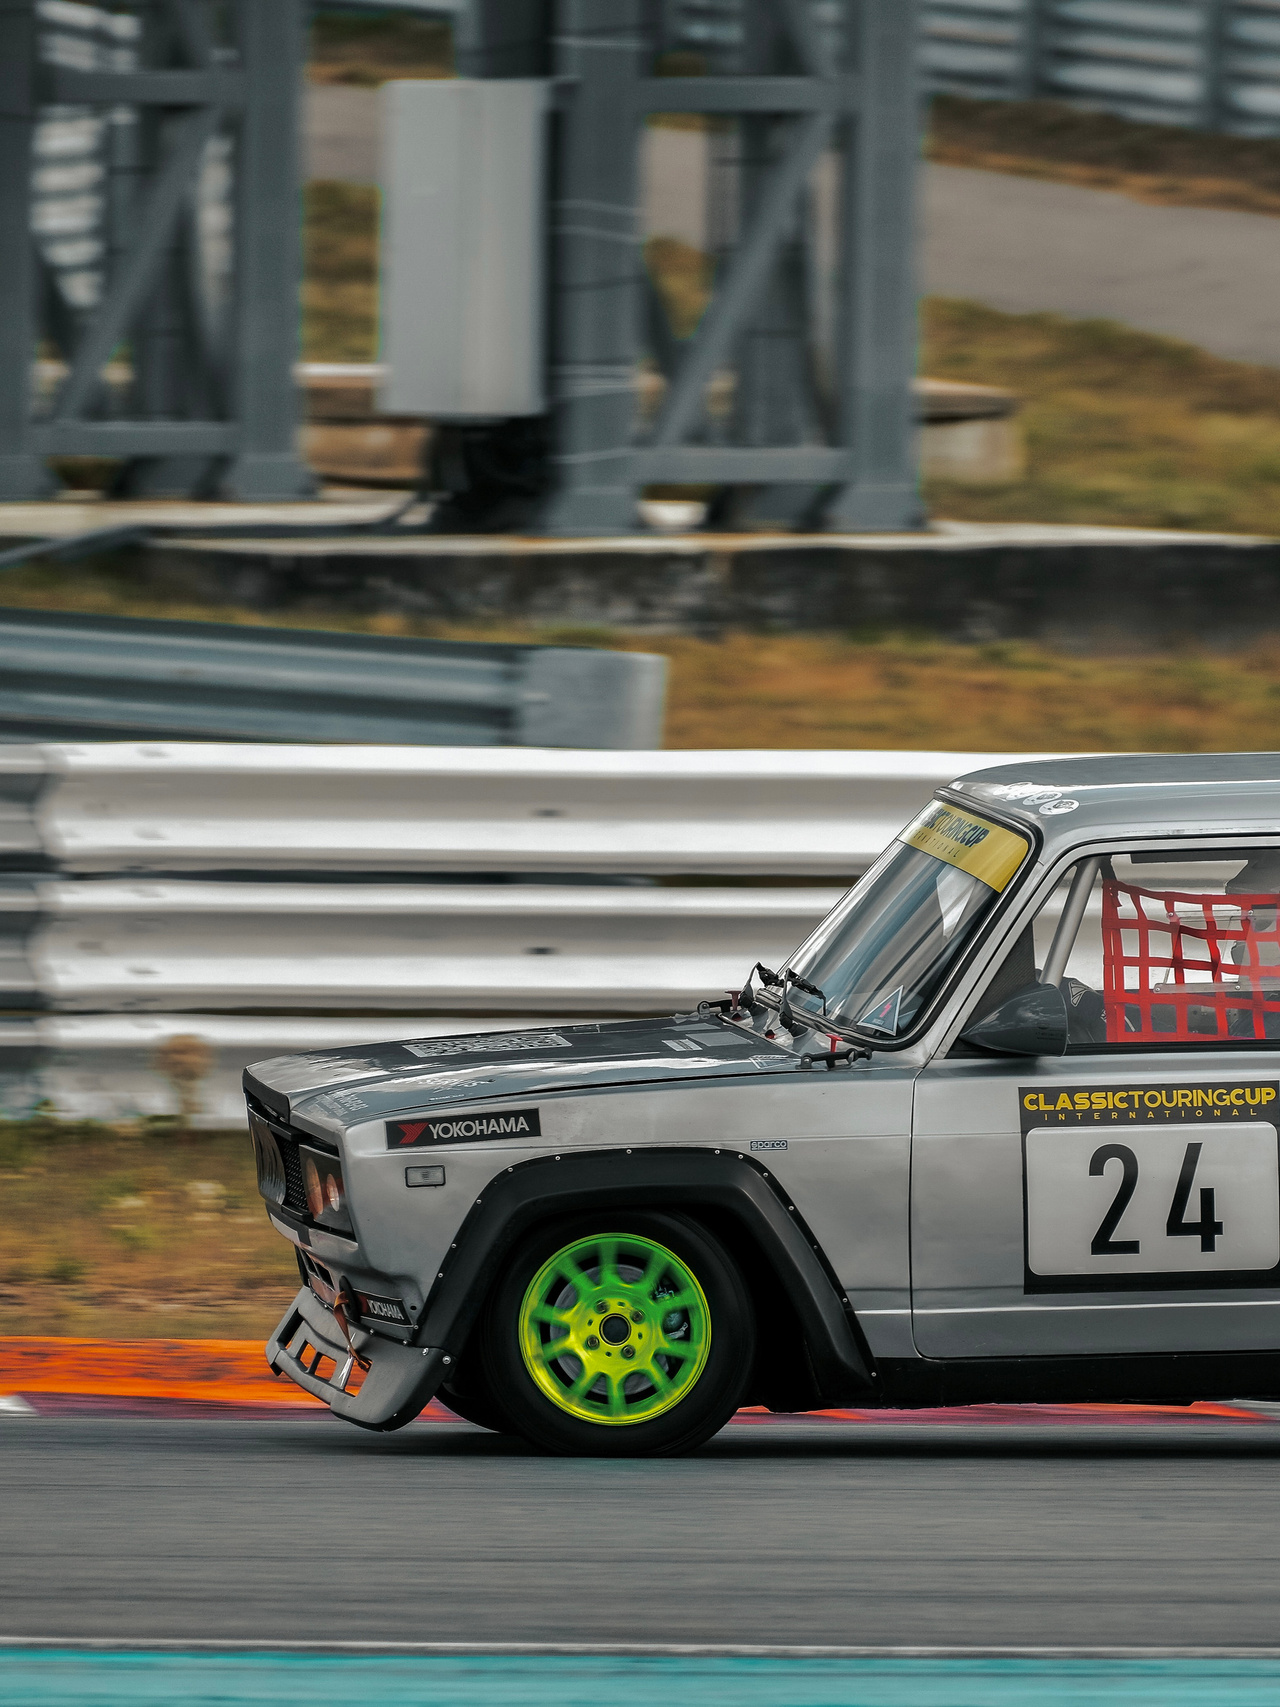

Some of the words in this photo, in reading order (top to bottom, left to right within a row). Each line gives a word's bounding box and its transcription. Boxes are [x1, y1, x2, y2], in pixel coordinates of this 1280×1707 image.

[1023, 1087, 1276, 1111] CLASSICTOURINGCUP
[1044, 1108, 1257, 1121] INTERNATIONAL
[428, 1116, 530, 1139] YOKOHAMA
[751, 1141, 787, 1150] sparco
[1088, 1142, 1224, 1255] 24
